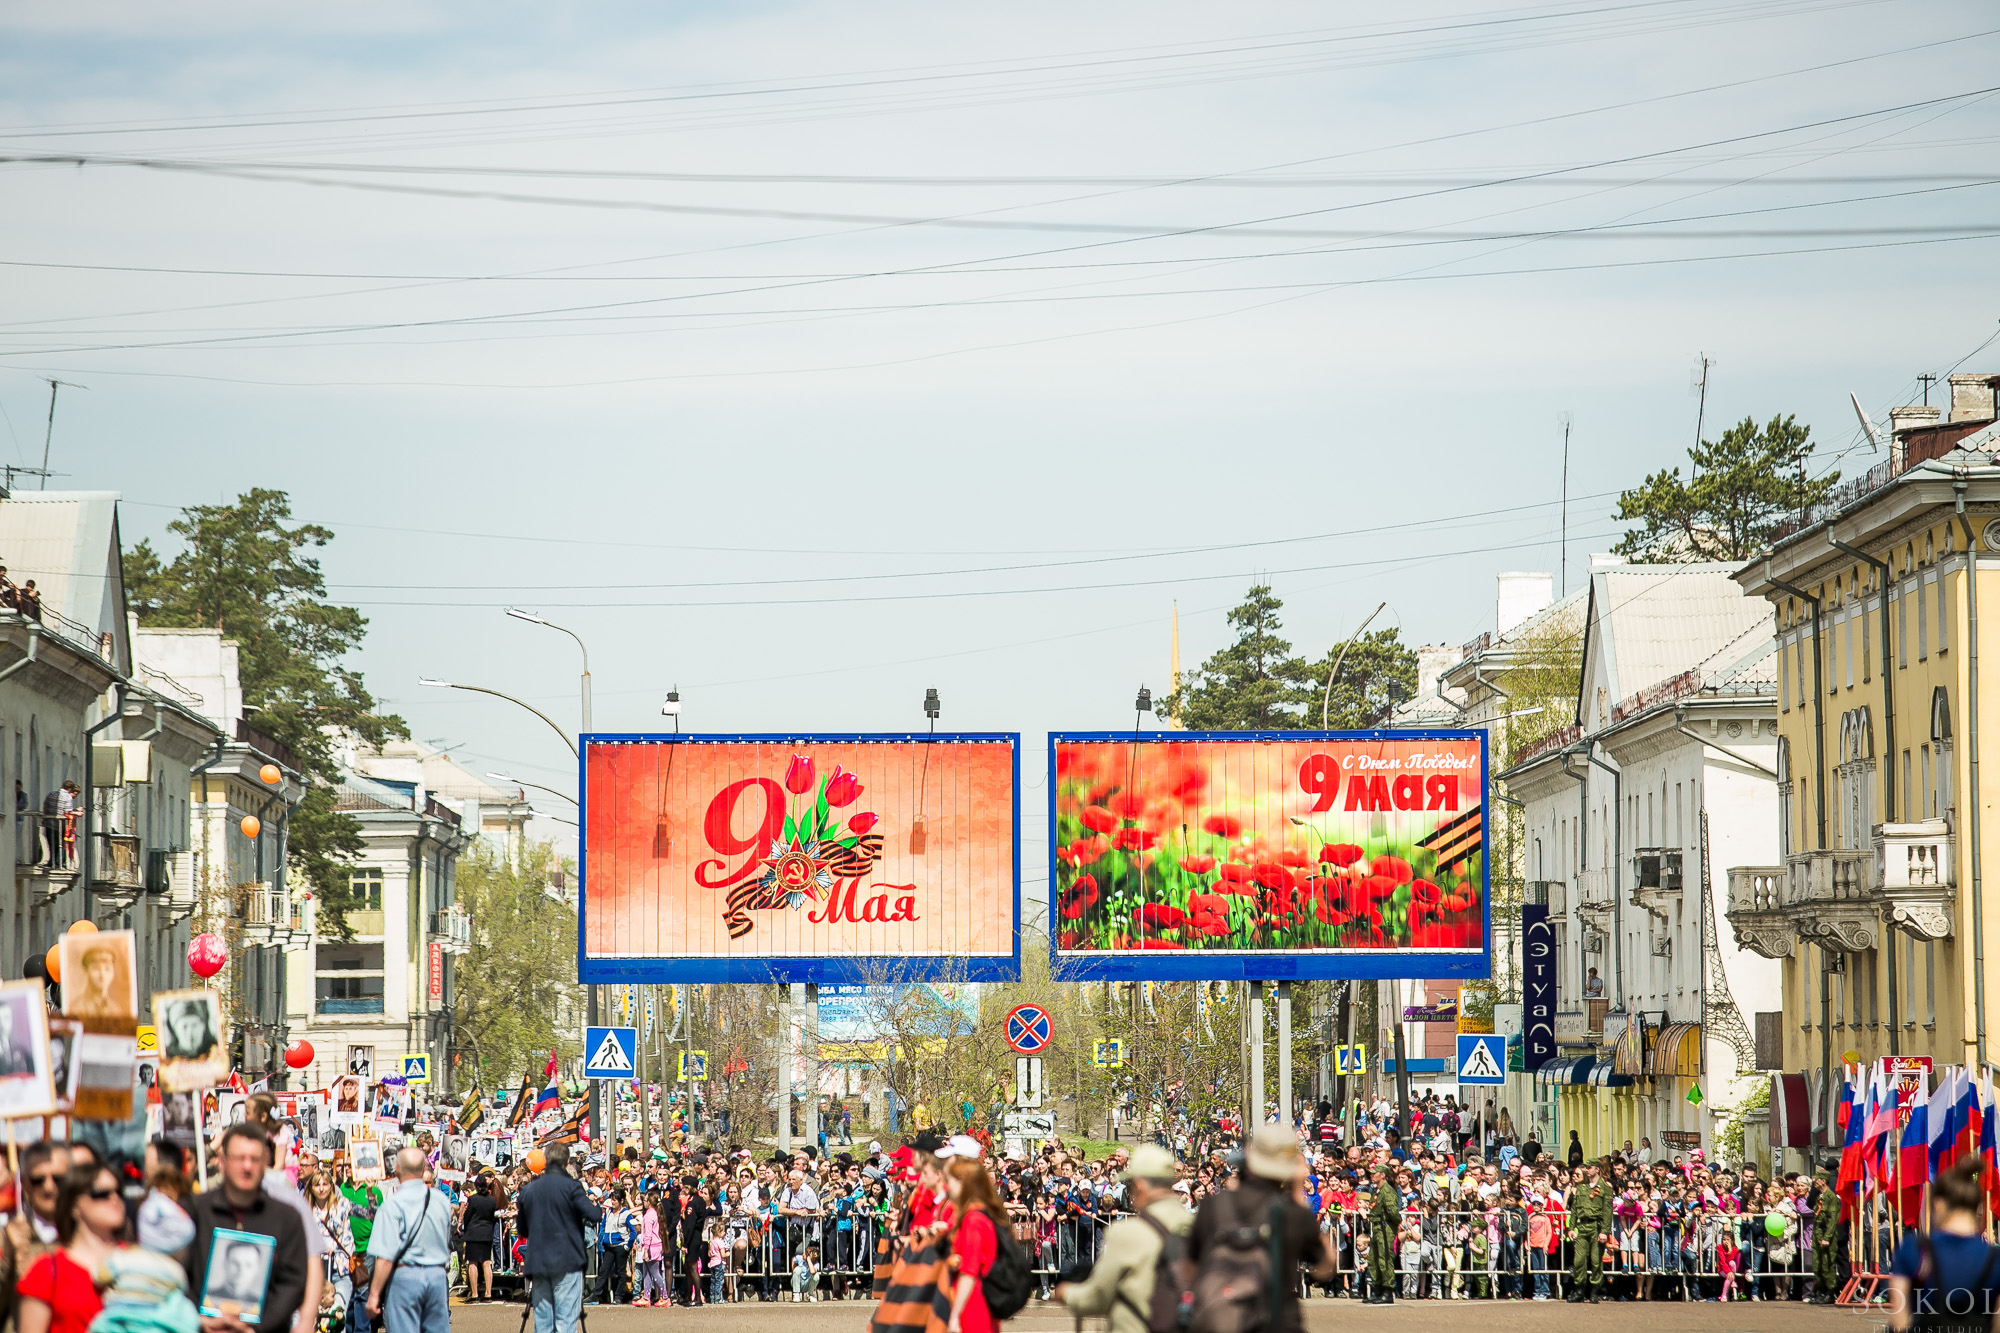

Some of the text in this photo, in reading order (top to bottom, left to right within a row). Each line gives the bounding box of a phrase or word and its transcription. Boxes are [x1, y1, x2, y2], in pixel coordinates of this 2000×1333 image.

[1299, 754, 1459, 812] 9 мая
[1342, 753, 1476, 770] С Днем Победы!
[694, 777, 787, 889] 9
[808, 877, 921, 924] Мая
[430, 944, 440, 999] АДВОКАТЫ
[818, 986, 836, 994] ЫБА
[838, 986, 863, 994] МЯСО
